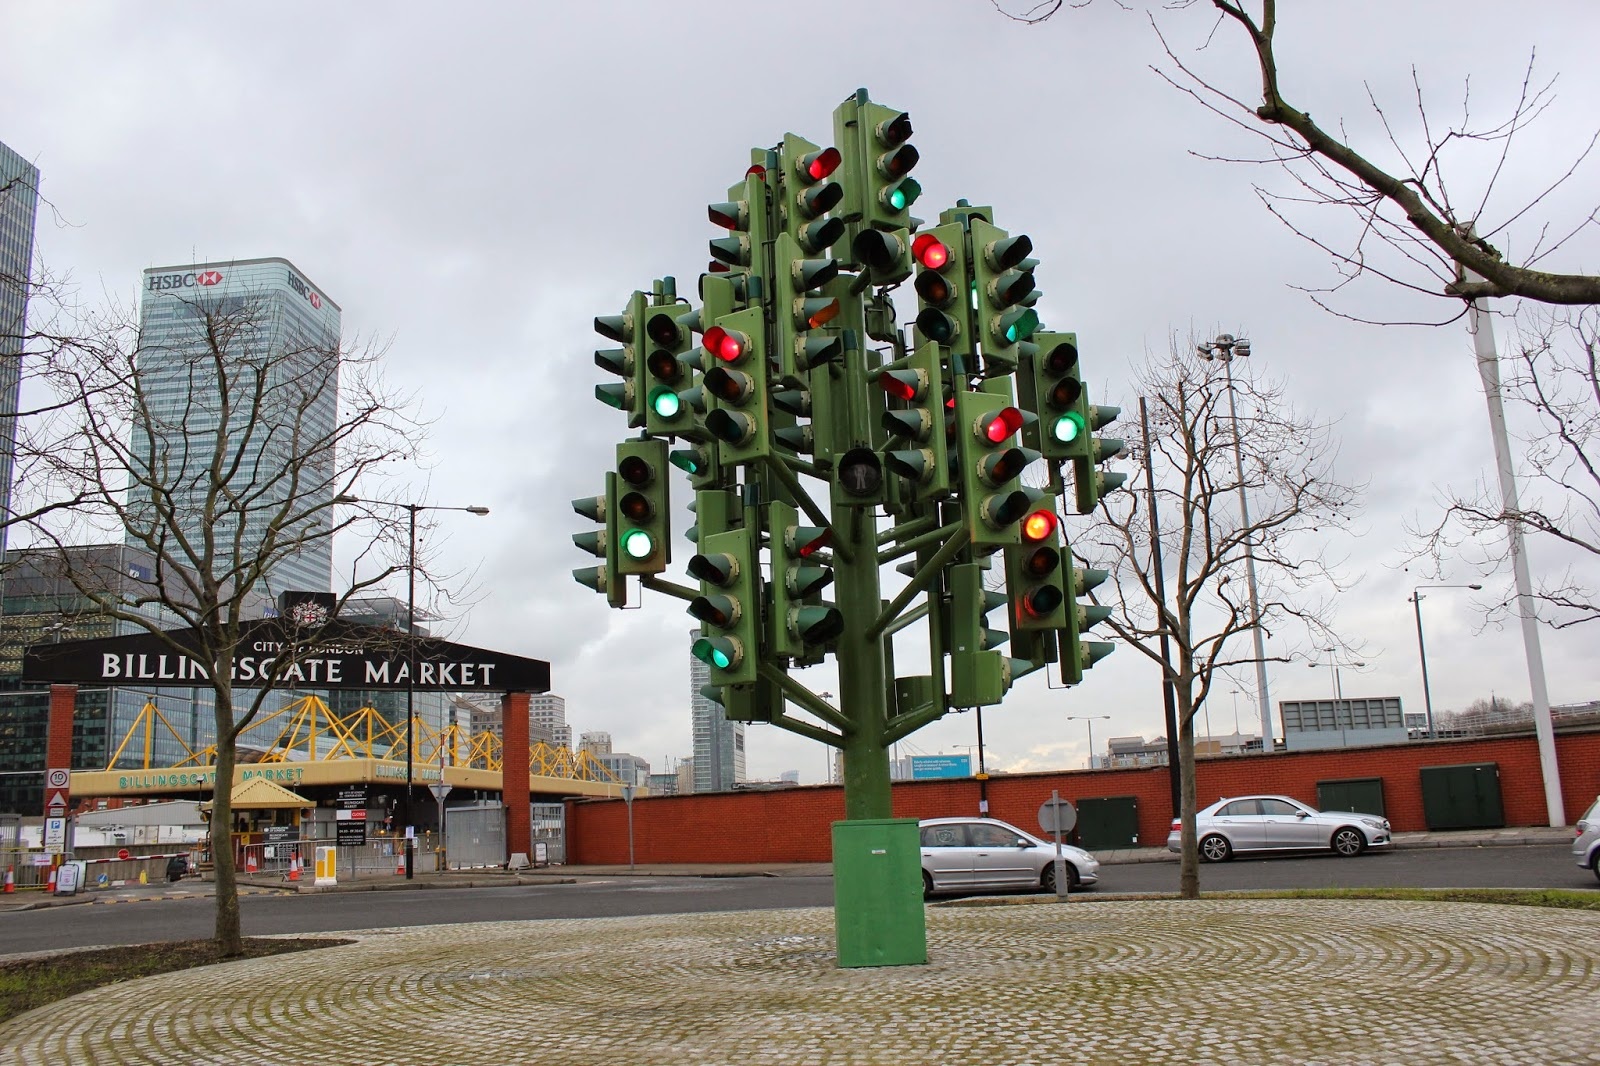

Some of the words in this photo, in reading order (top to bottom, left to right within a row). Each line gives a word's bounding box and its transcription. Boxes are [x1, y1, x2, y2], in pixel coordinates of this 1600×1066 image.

[148, 273, 196, 291] HSBC
[288, 270, 310, 300] HSBC
[253, 641, 283, 652] CITY
[364, 660, 496, 686] MARKET
[54, 773, 64, 781] 10
[242, 768, 304, 781] MARKET
